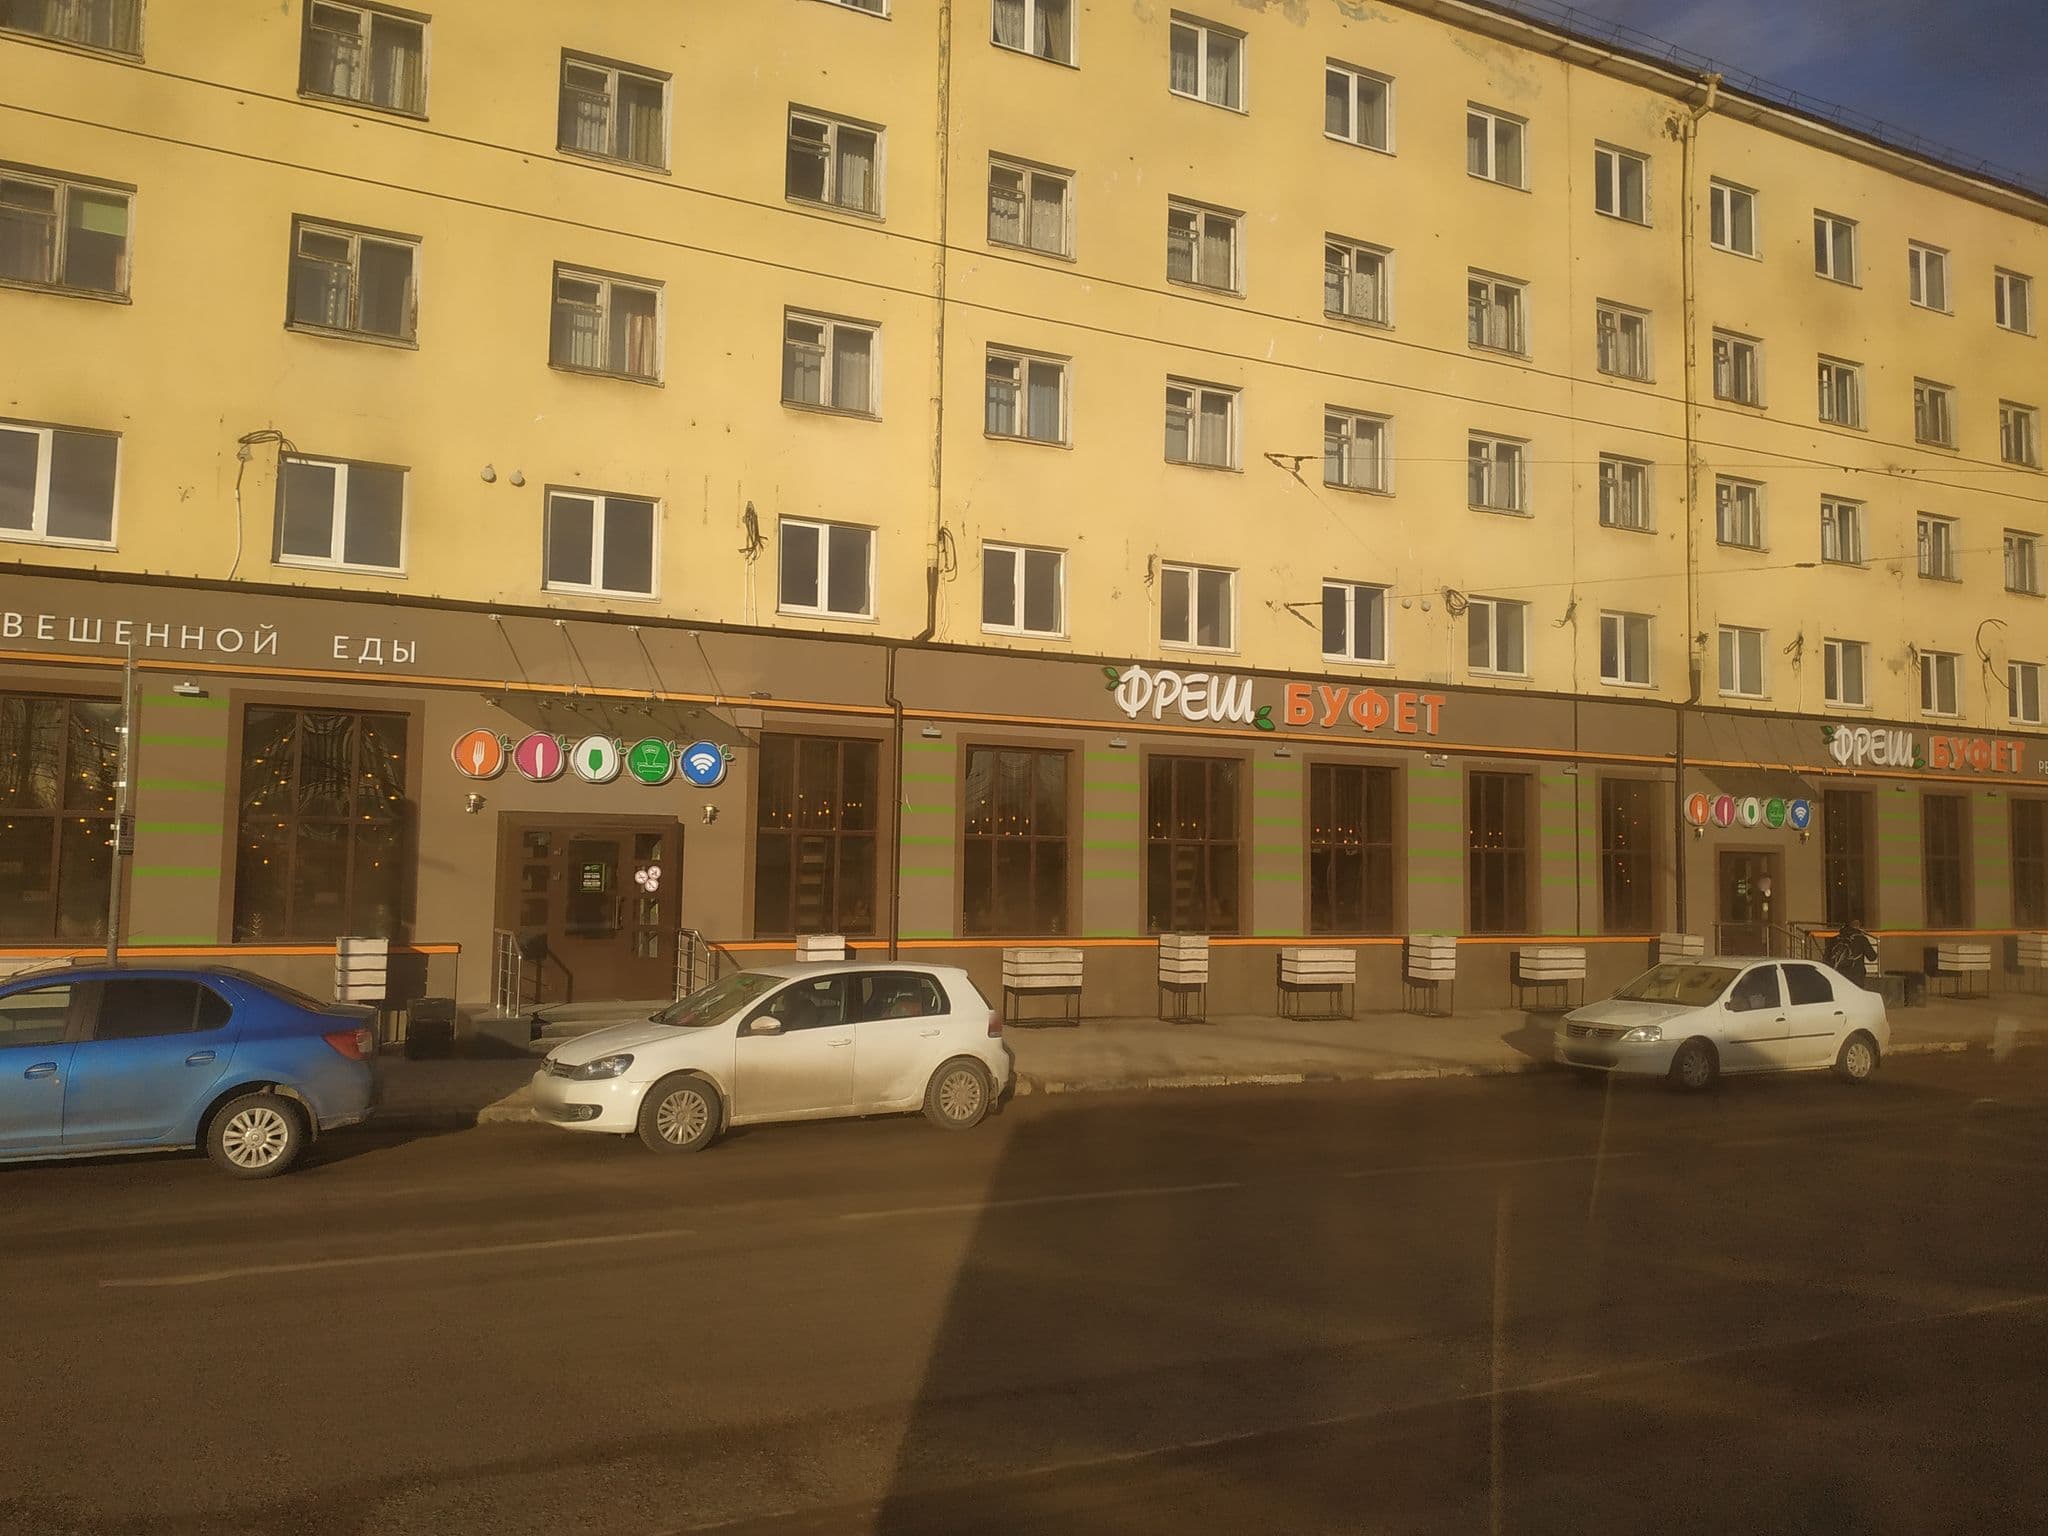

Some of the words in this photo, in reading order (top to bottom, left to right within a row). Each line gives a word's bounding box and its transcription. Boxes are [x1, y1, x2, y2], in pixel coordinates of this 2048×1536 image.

[0, 612, 279, 656] ВЕШЕННОЙ
[332, 635, 417, 666] ЕДЫ
[1114, 665, 1256, 726] ФРЕШ
[1283, 682, 1447, 735] БУФЕТ
[1828, 725, 1915, 769] ФРЕШ
[1928, 735, 2027, 773] БУФЕТ
